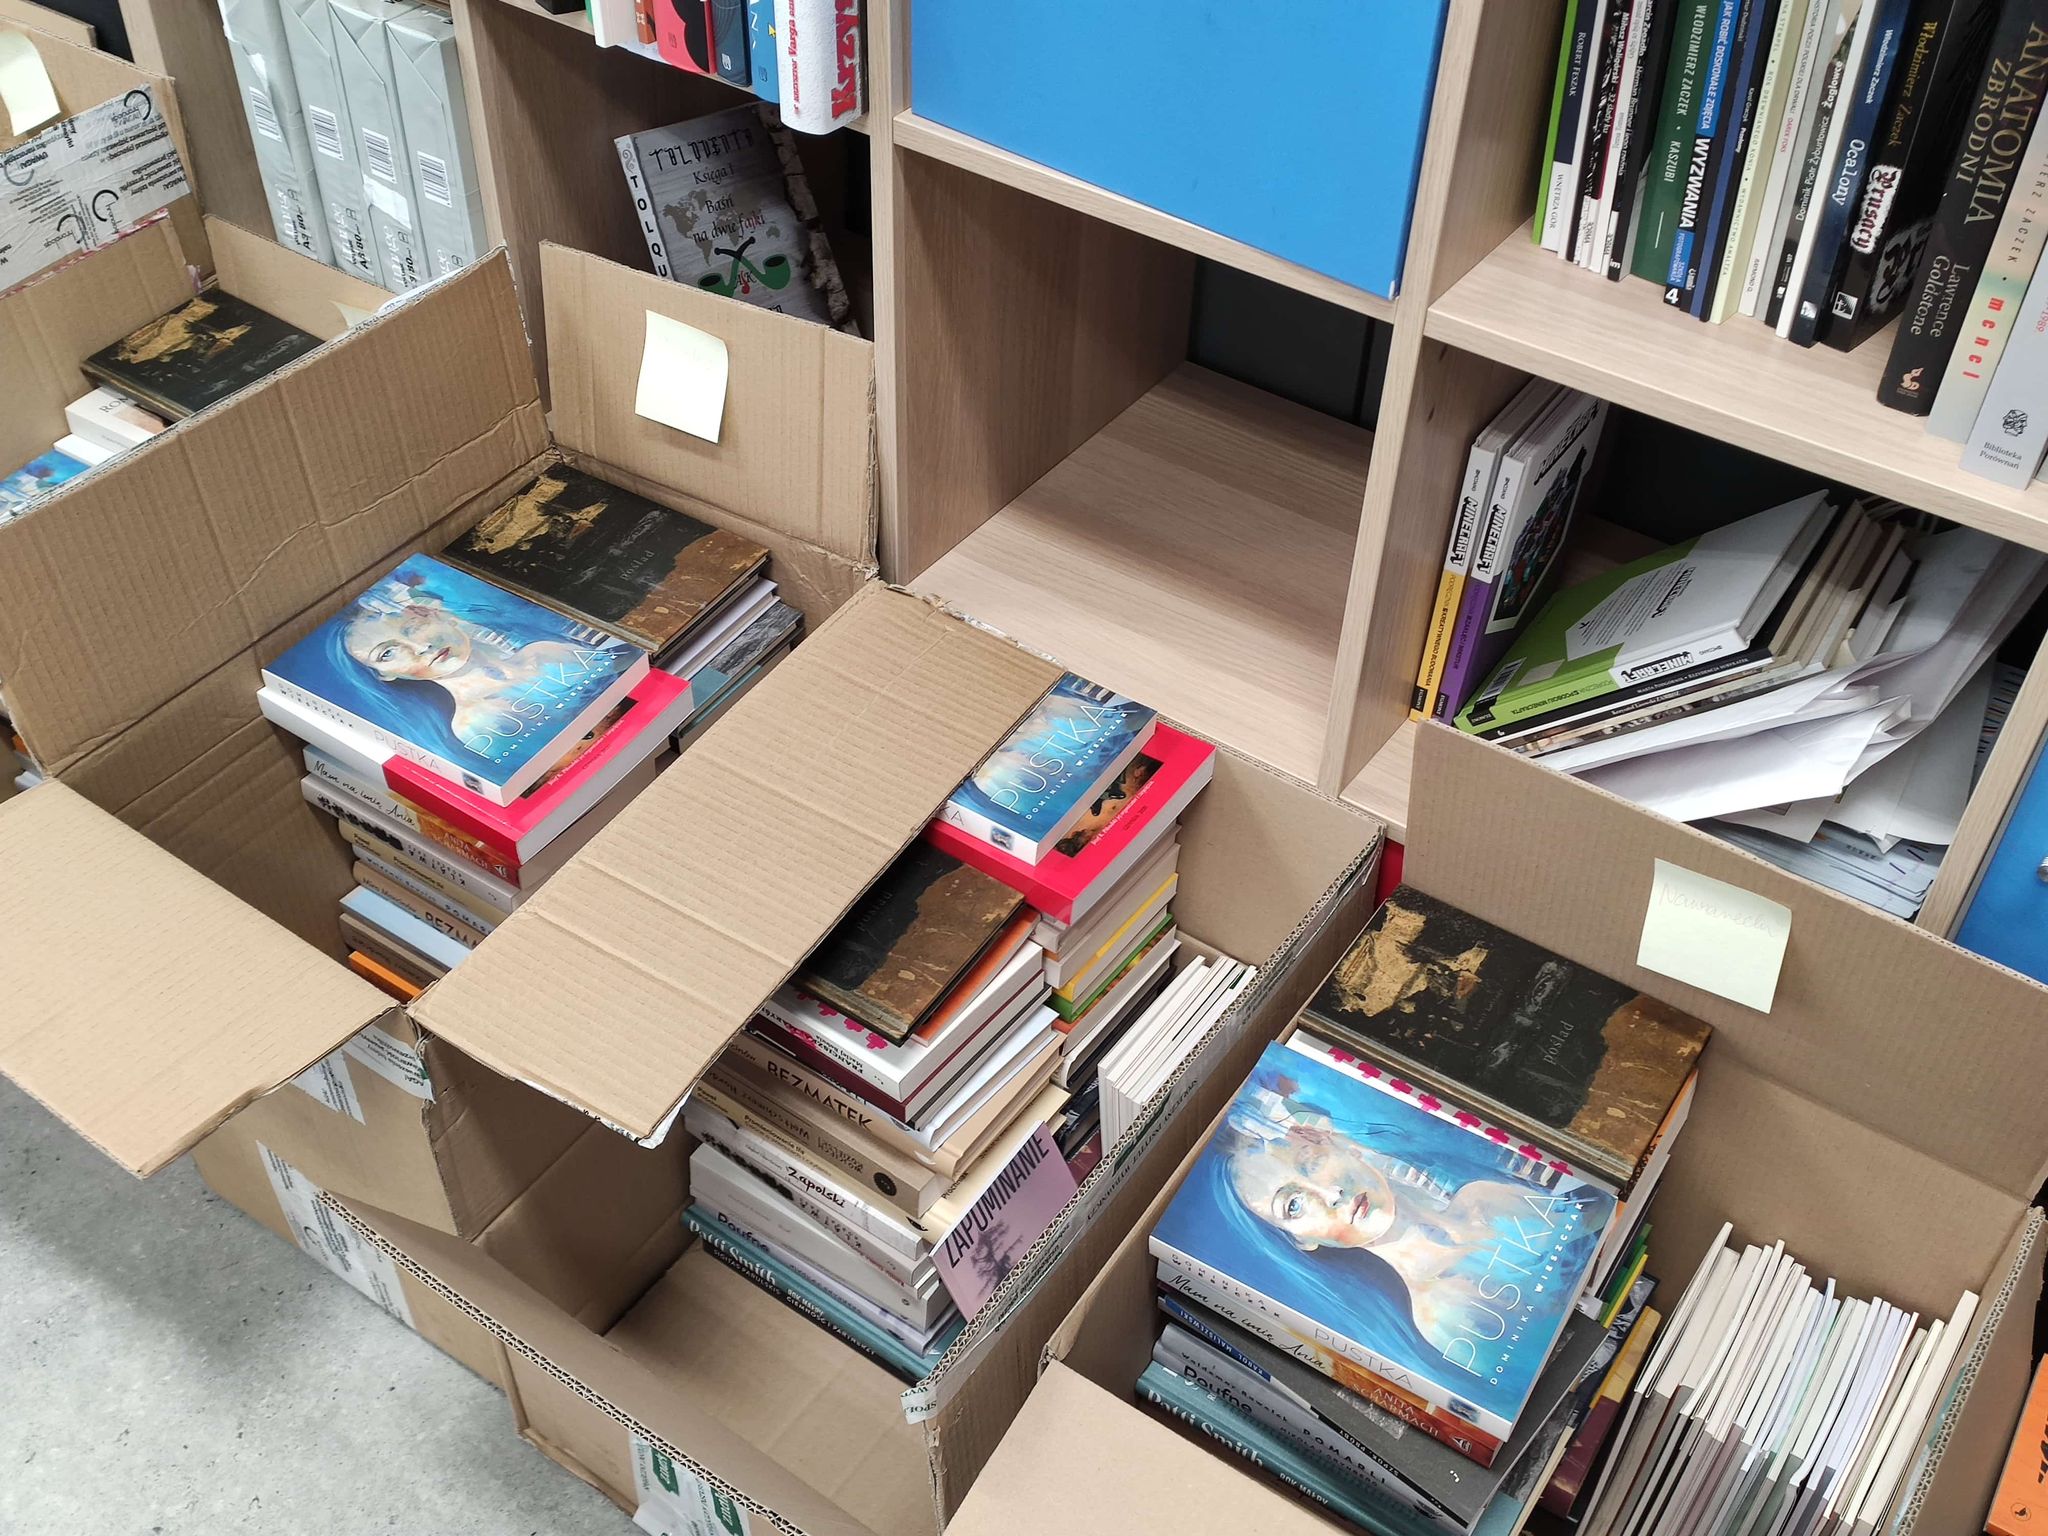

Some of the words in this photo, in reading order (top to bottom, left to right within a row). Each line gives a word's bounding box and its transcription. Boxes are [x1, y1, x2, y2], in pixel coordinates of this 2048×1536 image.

[1719, 17, 1731, 45] ROBIĆ
[1723, 0, 1734, 17] JAK
[1772, 18, 1786, 52] STEMPEL
[1574, 31, 1587, 64] ROBERT
[1684, 5, 1708, 76] WŁODZIMIERZ
[1873, 29, 1894, 77] Włodzimierz
[1903, 21, 1938, 98] Włodzimierz
[1569, 67, 1581, 96] FESZAK
[1676, 78, 1694, 115] ZACZEK
[1707, 45, 1726, 98] DOSKONAŁE
[1701, 99, 1716, 130] ZDJĘCIA
[1888, 103, 1914, 146] Zaczek
[1956, 57, 2015, 184] ZBRODNI
[1964, 21, 2048, 226] ANATOMIA
[693, 166, 727, 186] Księga
[1664, 141, 1682, 182] KASZUBI
[1679, 138, 1711, 228] WYZWANIA
[1832, 139, 1866, 207] Ocalony
[705, 192, 735, 214] Baśń
[1795, 185, 1813, 222] Dominik
[1804, 167, 1819, 186] Piotr
[1852, 169, 1899, 249] Prusacy
[692, 228, 710, 245] na
[711, 217, 738, 239] dwie
[738, 209, 767, 238] fajki
[2007, 206, 2037, 263] ZACZEK
[1665, 288, 1679, 304] 4
[1911, 255, 1951, 336] Goldstone
[1930, 262, 1970, 338] Lawrence
[1979, 449, 2020, 470] Porównań
[1983, 441, 2023, 462] Biblioteka
[1449, 496, 1480, 566] MINECRAFT
[1476, 503, 1508, 574] MINECRAFT
[1620, 649, 1695, 683] MINECRAFT
[464, 649, 608, 760] PUSTKA
[494, 714, 552, 764] DOMINIKA
[556, 650, 617, 709] WIESZCZAK
[374, 729, 443, 774] PUSTKA
[990, 704, 1117, 815] PUSTKA
[1025, 772, 1073, 820] DOMINIKA
[1076, 712, 1128, 767] WIESZCZAK
[313, 760, 340, 784] Mam
[341, 780, 358, 794] na
[386, 801, 417, 826] Ania
[1544, 1019, 1575, 1066] poślad
[767, 1060, 873, 1132] BEZMATEK
[786, 1166, 846, 1208] Zapolski
[945, 1132, 1050, 1270] ZAPOMINANIE
[688, 1219, 727, 1252] Patti
[729, 1245, 777, 1286] Smith
[717, 1211, 770, 1253] Poufne
[786, 1287, 802, 1302] ROK
[1172, 1253, 1264, 1305] DOMINIKA
[1442, 1195, 1569, 1377] PUSTKA
[1489, 1304, 1535, 1385] DOMINIKA
[1534, 1202, 1584, 1293] WIESZCZAK
[1169, 1274, 1209, 1304] Mam
[1214, 1302, 1237, 1320] na
[1241, 1317, 1275, 1342] imię
[1278, 1343, 1326, 1370] Ania
[1180, 1309, 1233, 1354] MALISZEWSKI
[1181, 1352, 1237, 1390] Waldemar
[1237, 1353, 1264, 1376] KAROL
[1314, 1328, 1413, 1389] PUSTKA
[1184, 1365, 1253, 1414] Poufne
[1352, 1383, 1440, 1437] SCHARMACH
[1374, 1387, 1415, 1415] ANITA
[1145, 1386, 1197, 1425] Patti
[1201, 1421, 1264, 1467] Smith
[1302, 1428, 1387, 1484] POMARLI
